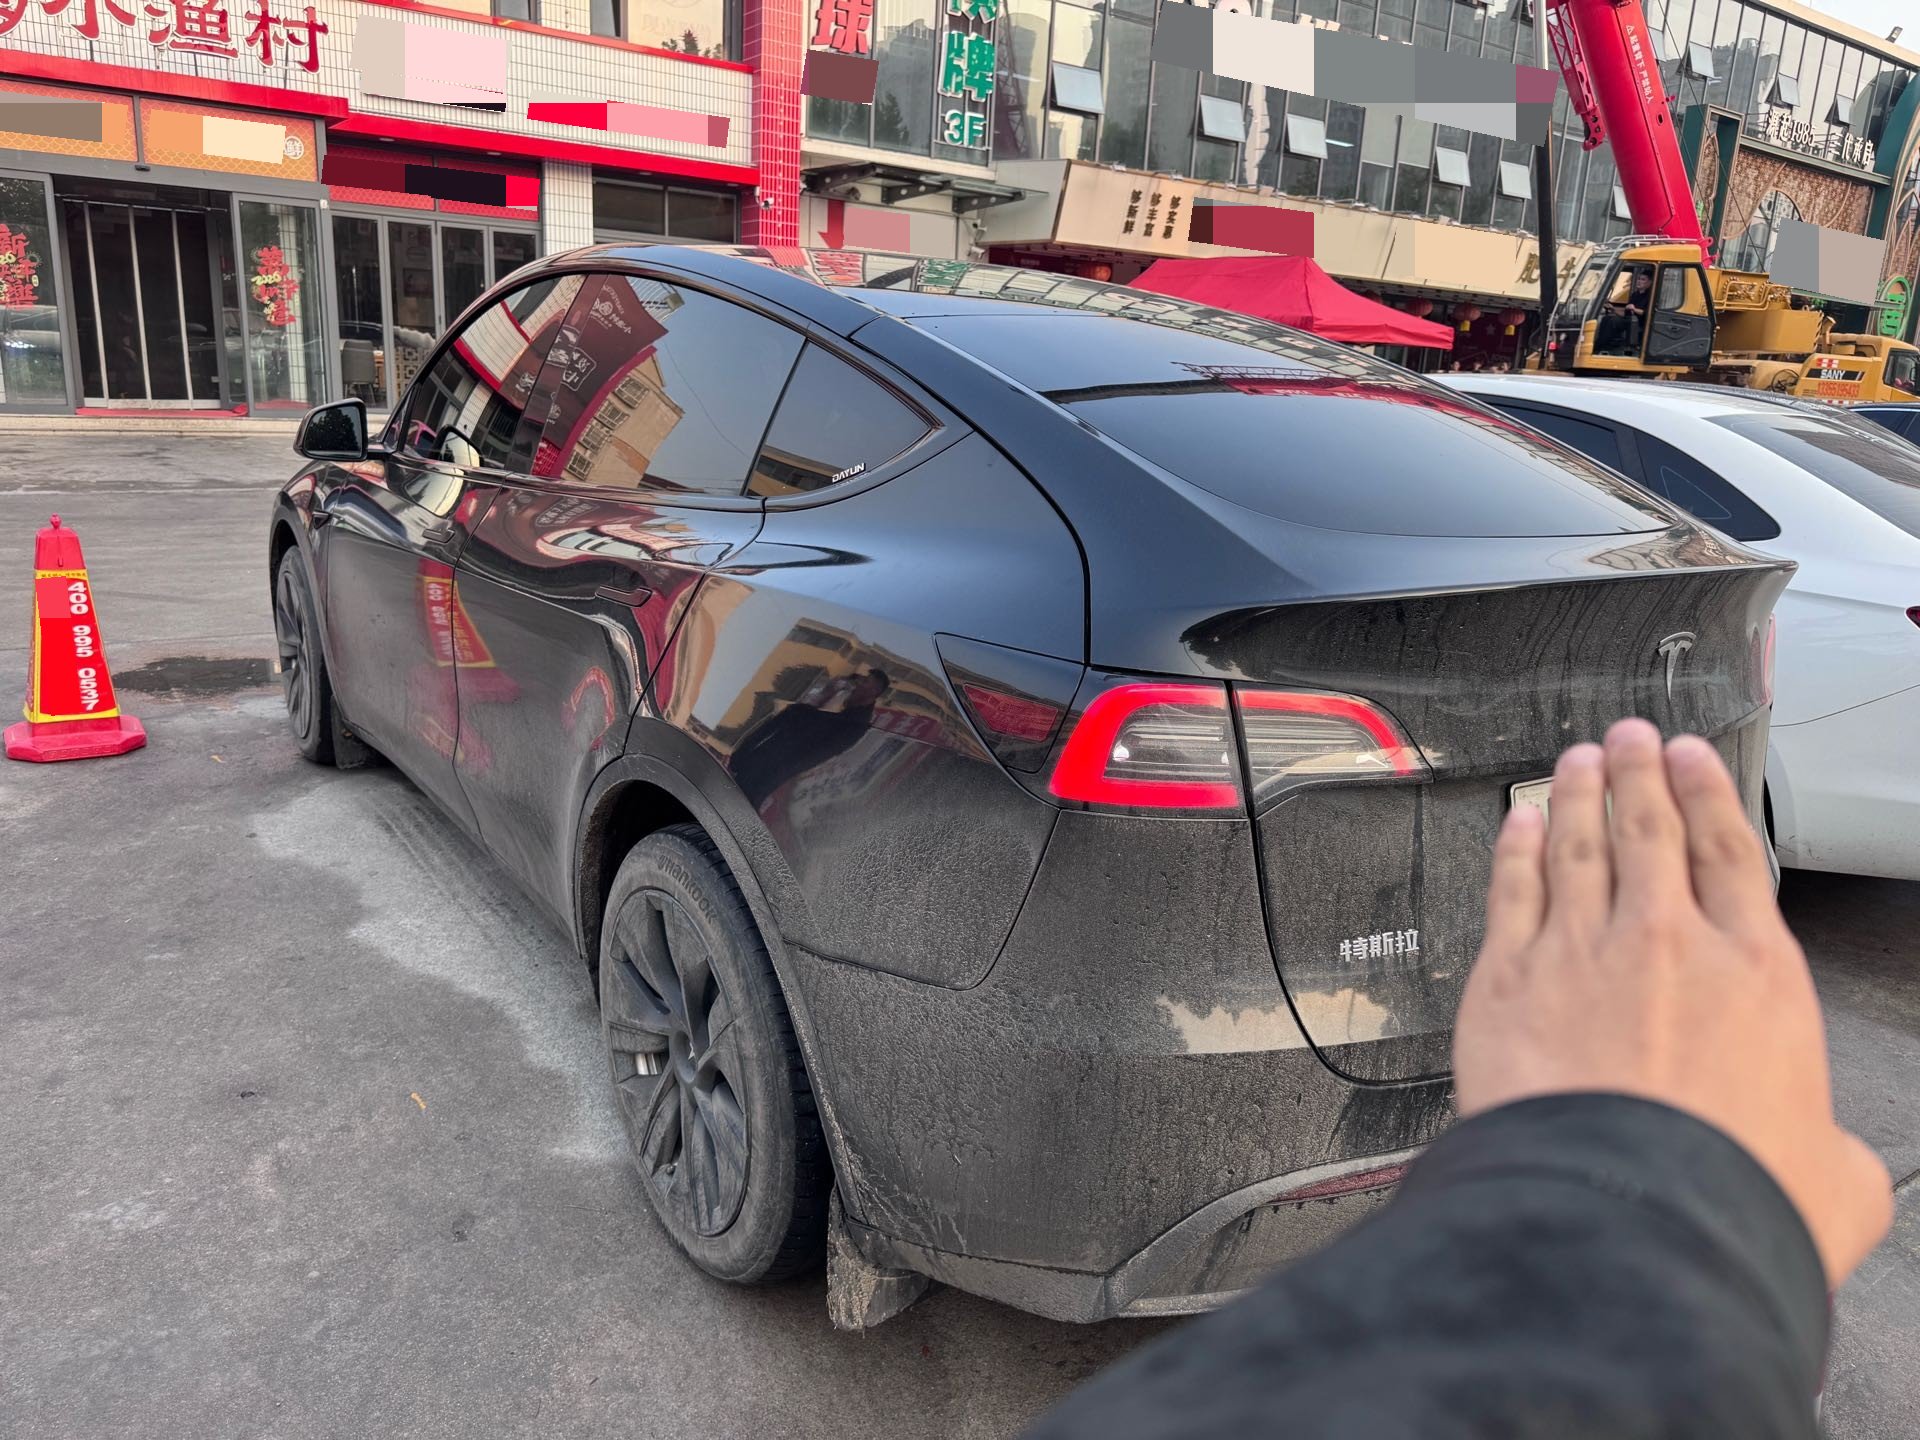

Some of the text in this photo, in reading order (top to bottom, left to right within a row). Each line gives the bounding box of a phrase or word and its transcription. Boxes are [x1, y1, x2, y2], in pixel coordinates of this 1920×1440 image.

[943, 109, 986, 148] 3F
[1122, 189, 1142, 234] 够新鲜
[1143, 192, 1162, 237] 够丰富
[1162, 195, 1181, 239] 够实惠
[1820, 369, 1846, 380] SANY
[832, 462, 866, 483] DAYUN
[67, 581, 100, 711] 400 995 0537
[1340, 929, 1420, 961] 特斯拉
